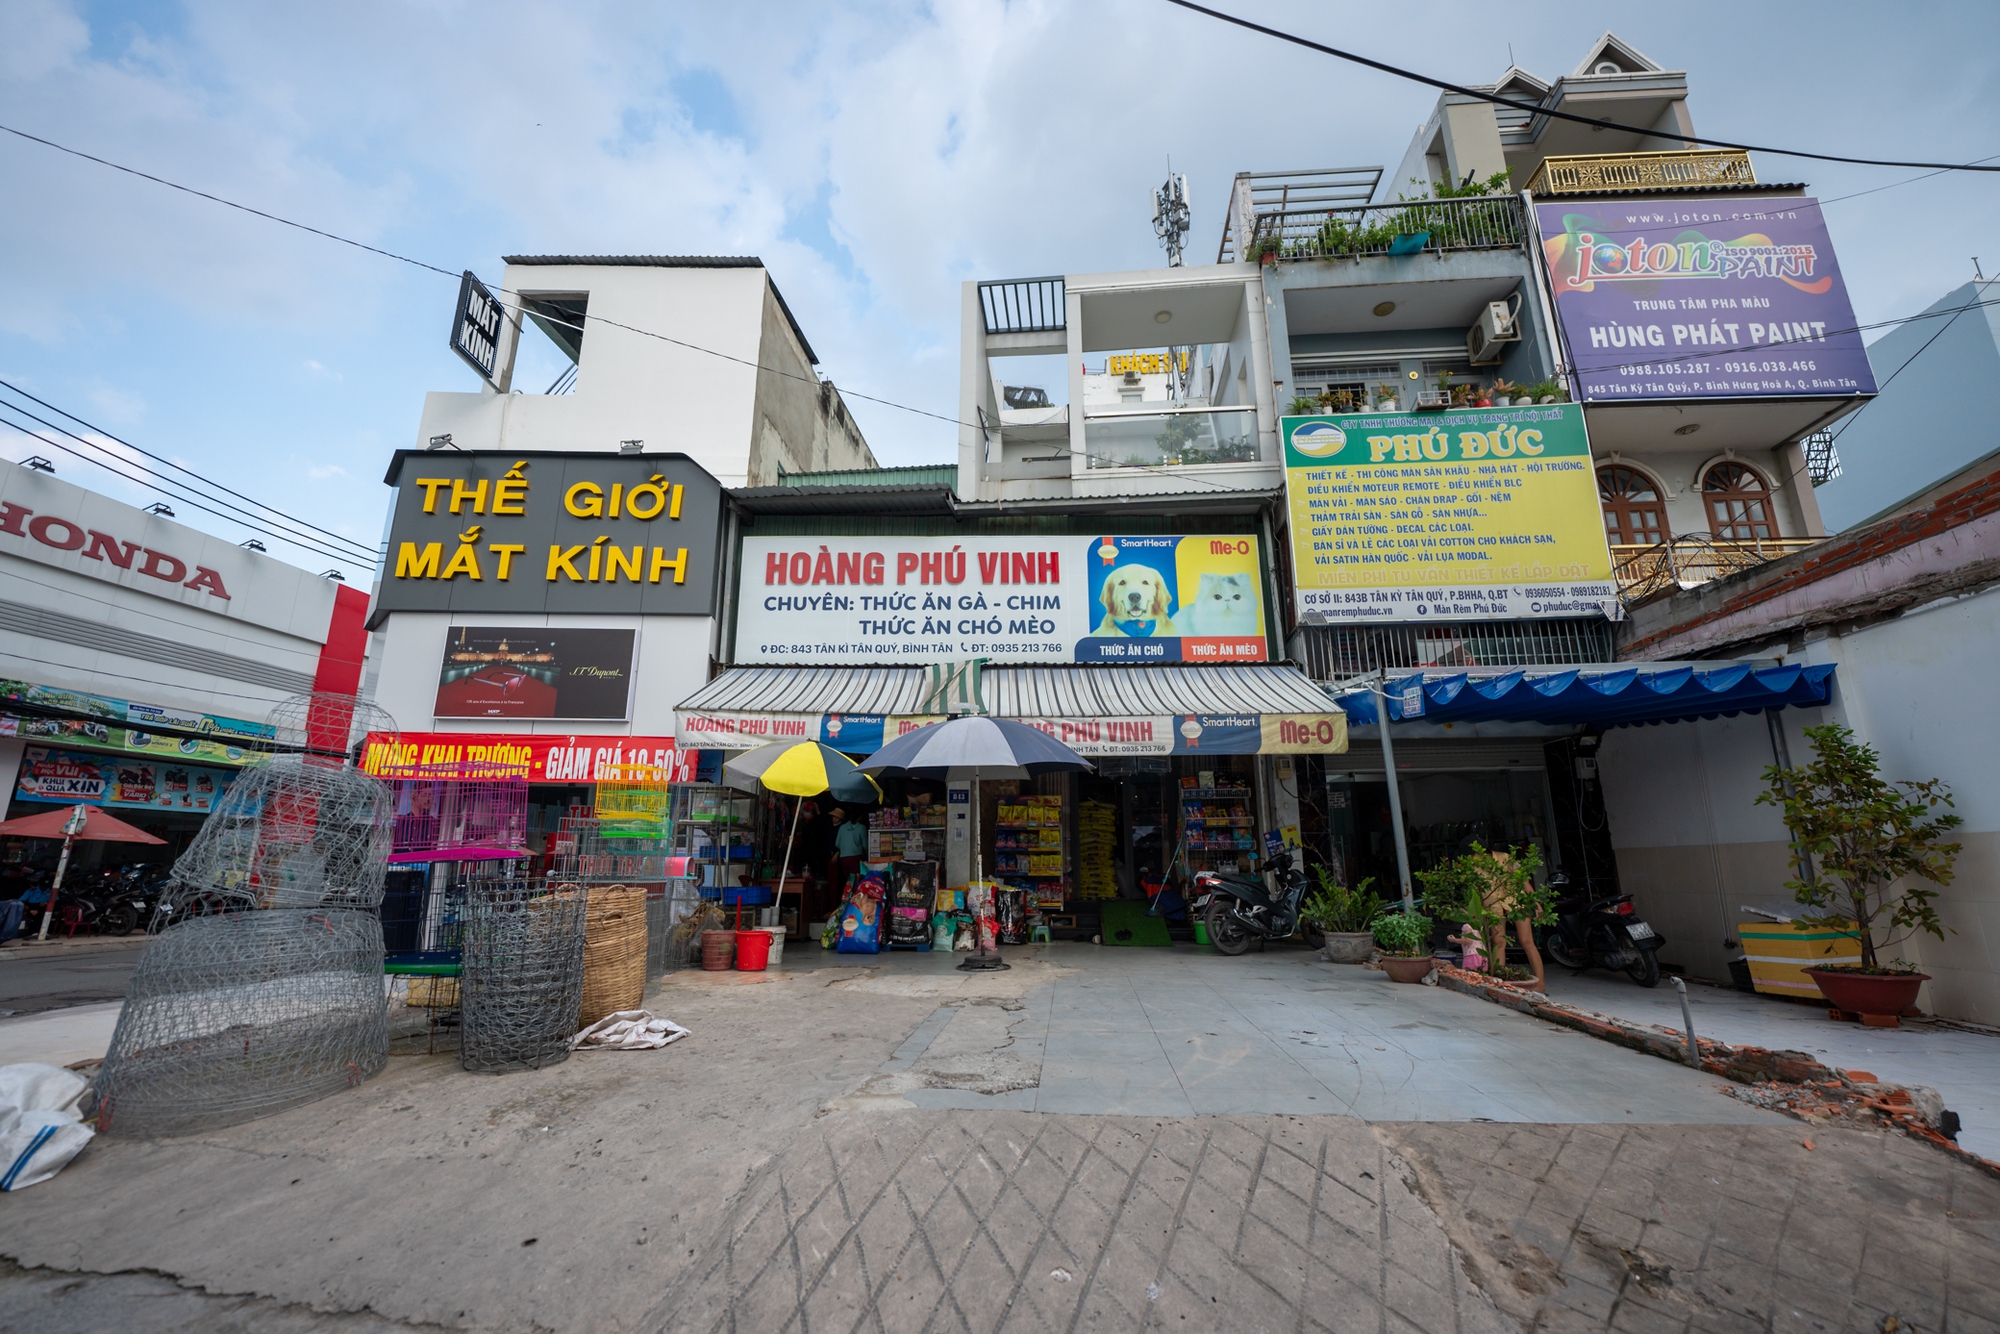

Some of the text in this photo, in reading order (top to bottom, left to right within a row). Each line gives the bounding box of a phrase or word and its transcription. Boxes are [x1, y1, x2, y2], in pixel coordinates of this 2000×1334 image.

[1626, 212, 1796, 224] www.joton.com.vn
[1568, 233, 1714, 284] joton
[1725, 245, 1813, 256] ISO 9001:2015
[1717, 254, 1817, 279] PAINT
[1633, 297, 1770, 311] TRUNG TÂM PHA MÀU
[468, 289, 499, 337] MẮT
[1589, 318, 1826, 348] HÙNG PHÁT PAINT
[461, 320, 494, 372] KÍNH
[1110, 350, 1159, 376] KHÁCH
[1620, 361, 1817, 376] 0988.105.287 0916.038.466
[1588, 378, 1857, 394] 845 Tân Kỳ Tân Bình Hưng Hoà Bình Tân
[1359, 413, 1508, 429] TNHH TRANG
[1366, 423, 1545, 462] PHÚ ĐỨC
[1306, 461, 1544, 481] THIẾT THI CÔNG MÀN SÂN KHẤU NHÀ HÁT HỘI
[415, 460, 684, 520] THẾ GIỚI
[1362, 479, 1522, 493] MOTEUR REMOTE BLC
[1309, 492, 1512, 508] MÀN MÀN SÁO DRAP NỆM
[1310, 508, 1451, 522] THẢM TRẢI SÀN SÀN SÀN
[1312, 522, 1448, 536] GIẤY DÁN DECAL CÁC
[0, 501, 231, 600] HONDA
[1121, 539, 1173, 548] SmartHeart
[1209, 540, 1250, 555] Me-O
[1314, 533, 1532, 551] BÁN CÁC LOẠI COTTON CHO KHÁCH
[394, 525, 689, 584] MẮT KÍNH
[1332, 551, 1409, 564] SATIN HÀN QUỐC
[765, 544, 1060, 586] HOÀNG PHÚ VINH
[764, 591, 1061, 612] CHUYÊN: THỨC ĂN GÀ CHIM
[1344, 586, 1611, 603] 843B TÂN TÂN Q.BT 0936050554 0989182181
[1434, 604, 1451, 614] Màn
[1453, 603, 1472, 613] Rèm
[1474, 603, 1490, 613] Phú
[1492, 602, 1508, 613] Đức
[859, 614, 1056, 635] THỨC ĂN CHÓ MÈO
[791, 642, 1062, 654] 843 TÂN KÌ TÂN QUÝ, BÌNH TÂN ĐT: 0935 213 766
[1100, 643, 1164, 656] THỨC ĂN CHÓ
[1191, 642, 1258, 656] THỨC ĂN MÈO
[685, 715, 806, 736] HOÀNG PHÚ VINH
[843, 715, 880, 724] SmartHeart
[1202, 716, 1255, 727] SmartHeart
[1061, 718, 1101, 743] PHÚ
[1106, 721, 1153, 742] VINH
[1280, 719, 1334, 745] Me-O
[364, 736, 418, 777] MỪNG
[418, 744, 462, 777] KHAI
[545, 736, 592, 780] GIẢM
[593, 741, 623, 781] GIÁ
[628, 749, 690, 783] 10-50%
